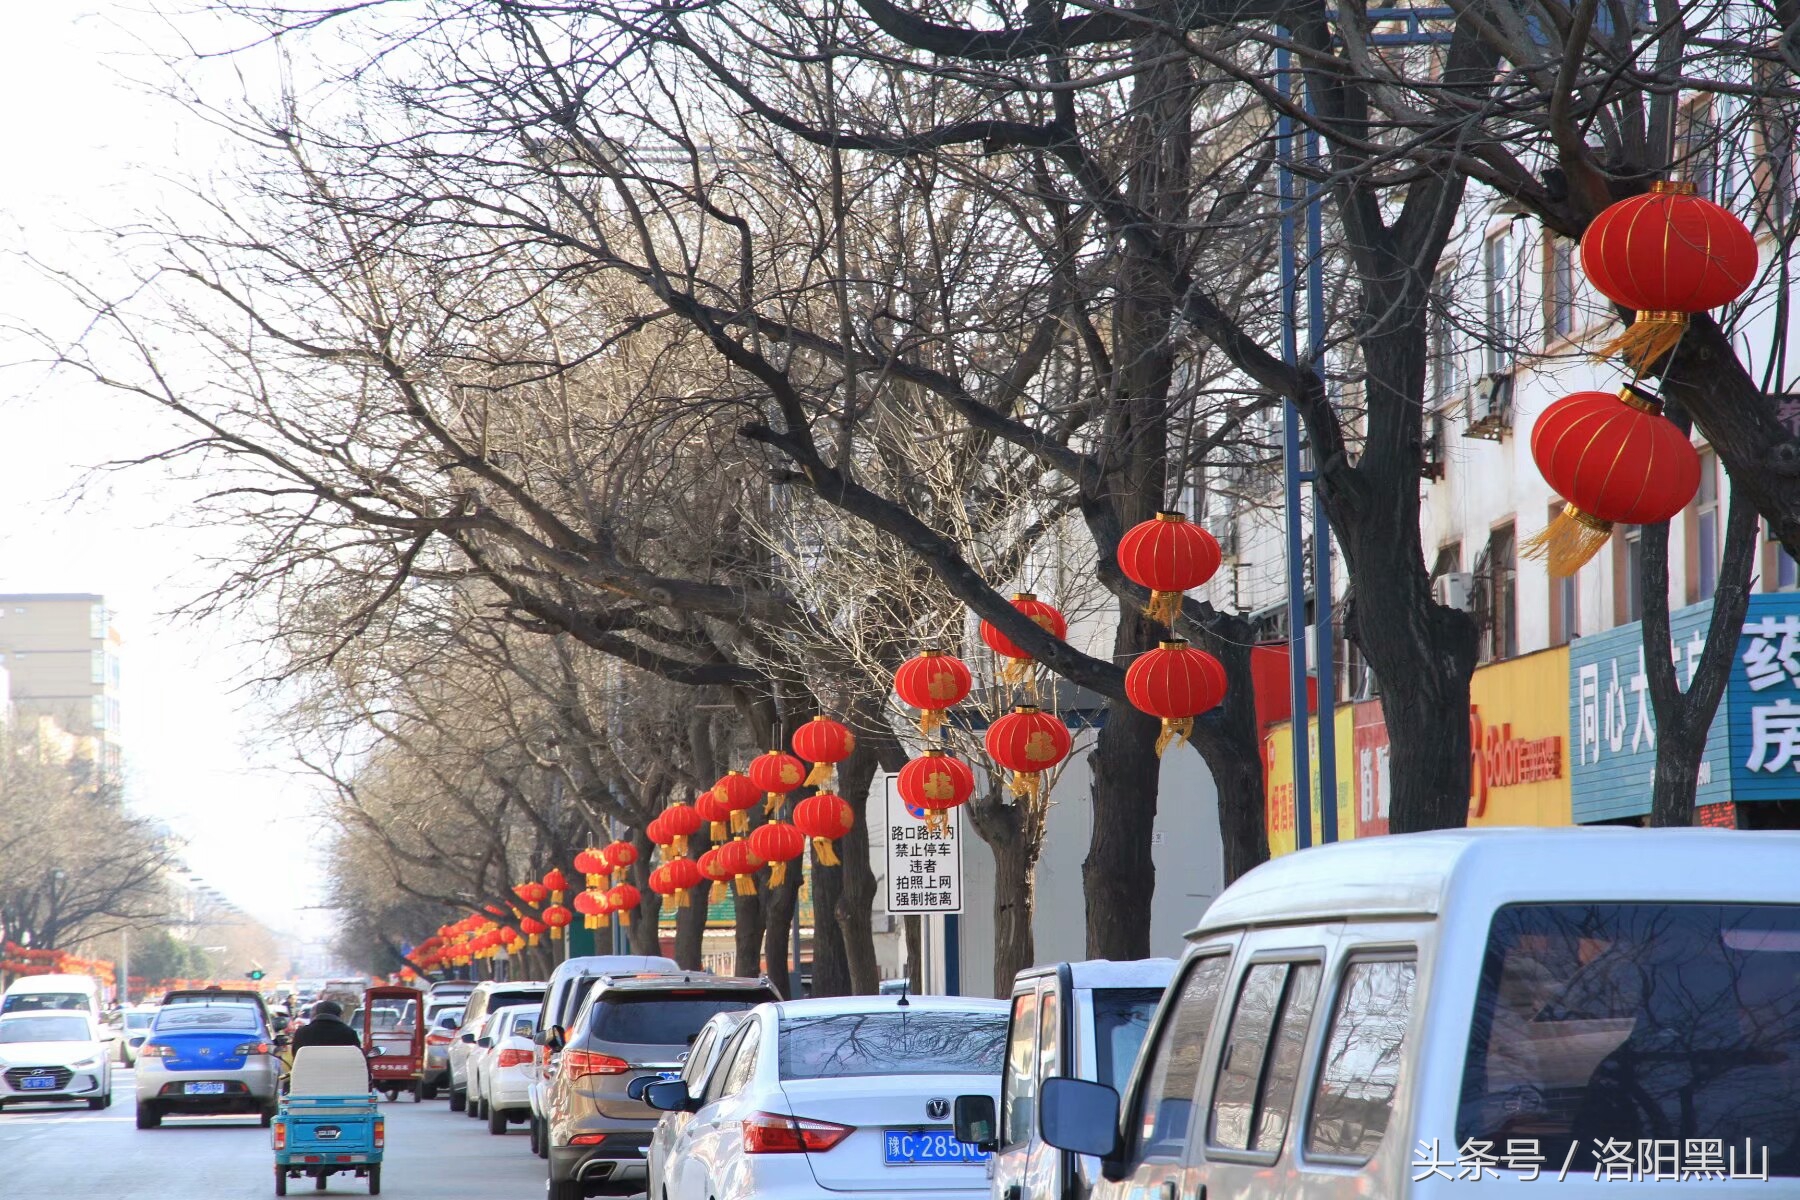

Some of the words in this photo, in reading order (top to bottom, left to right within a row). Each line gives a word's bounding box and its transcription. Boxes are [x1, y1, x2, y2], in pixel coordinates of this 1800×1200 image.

[891, 826, 954, 841] 路口路段内
[895, 843, 951, 858] 禁止停车
[909, 859, 937, 874] 违者
[896, 875, 952, 890] 拍照上网
[895, 892, 952, 907] 强制拖离
